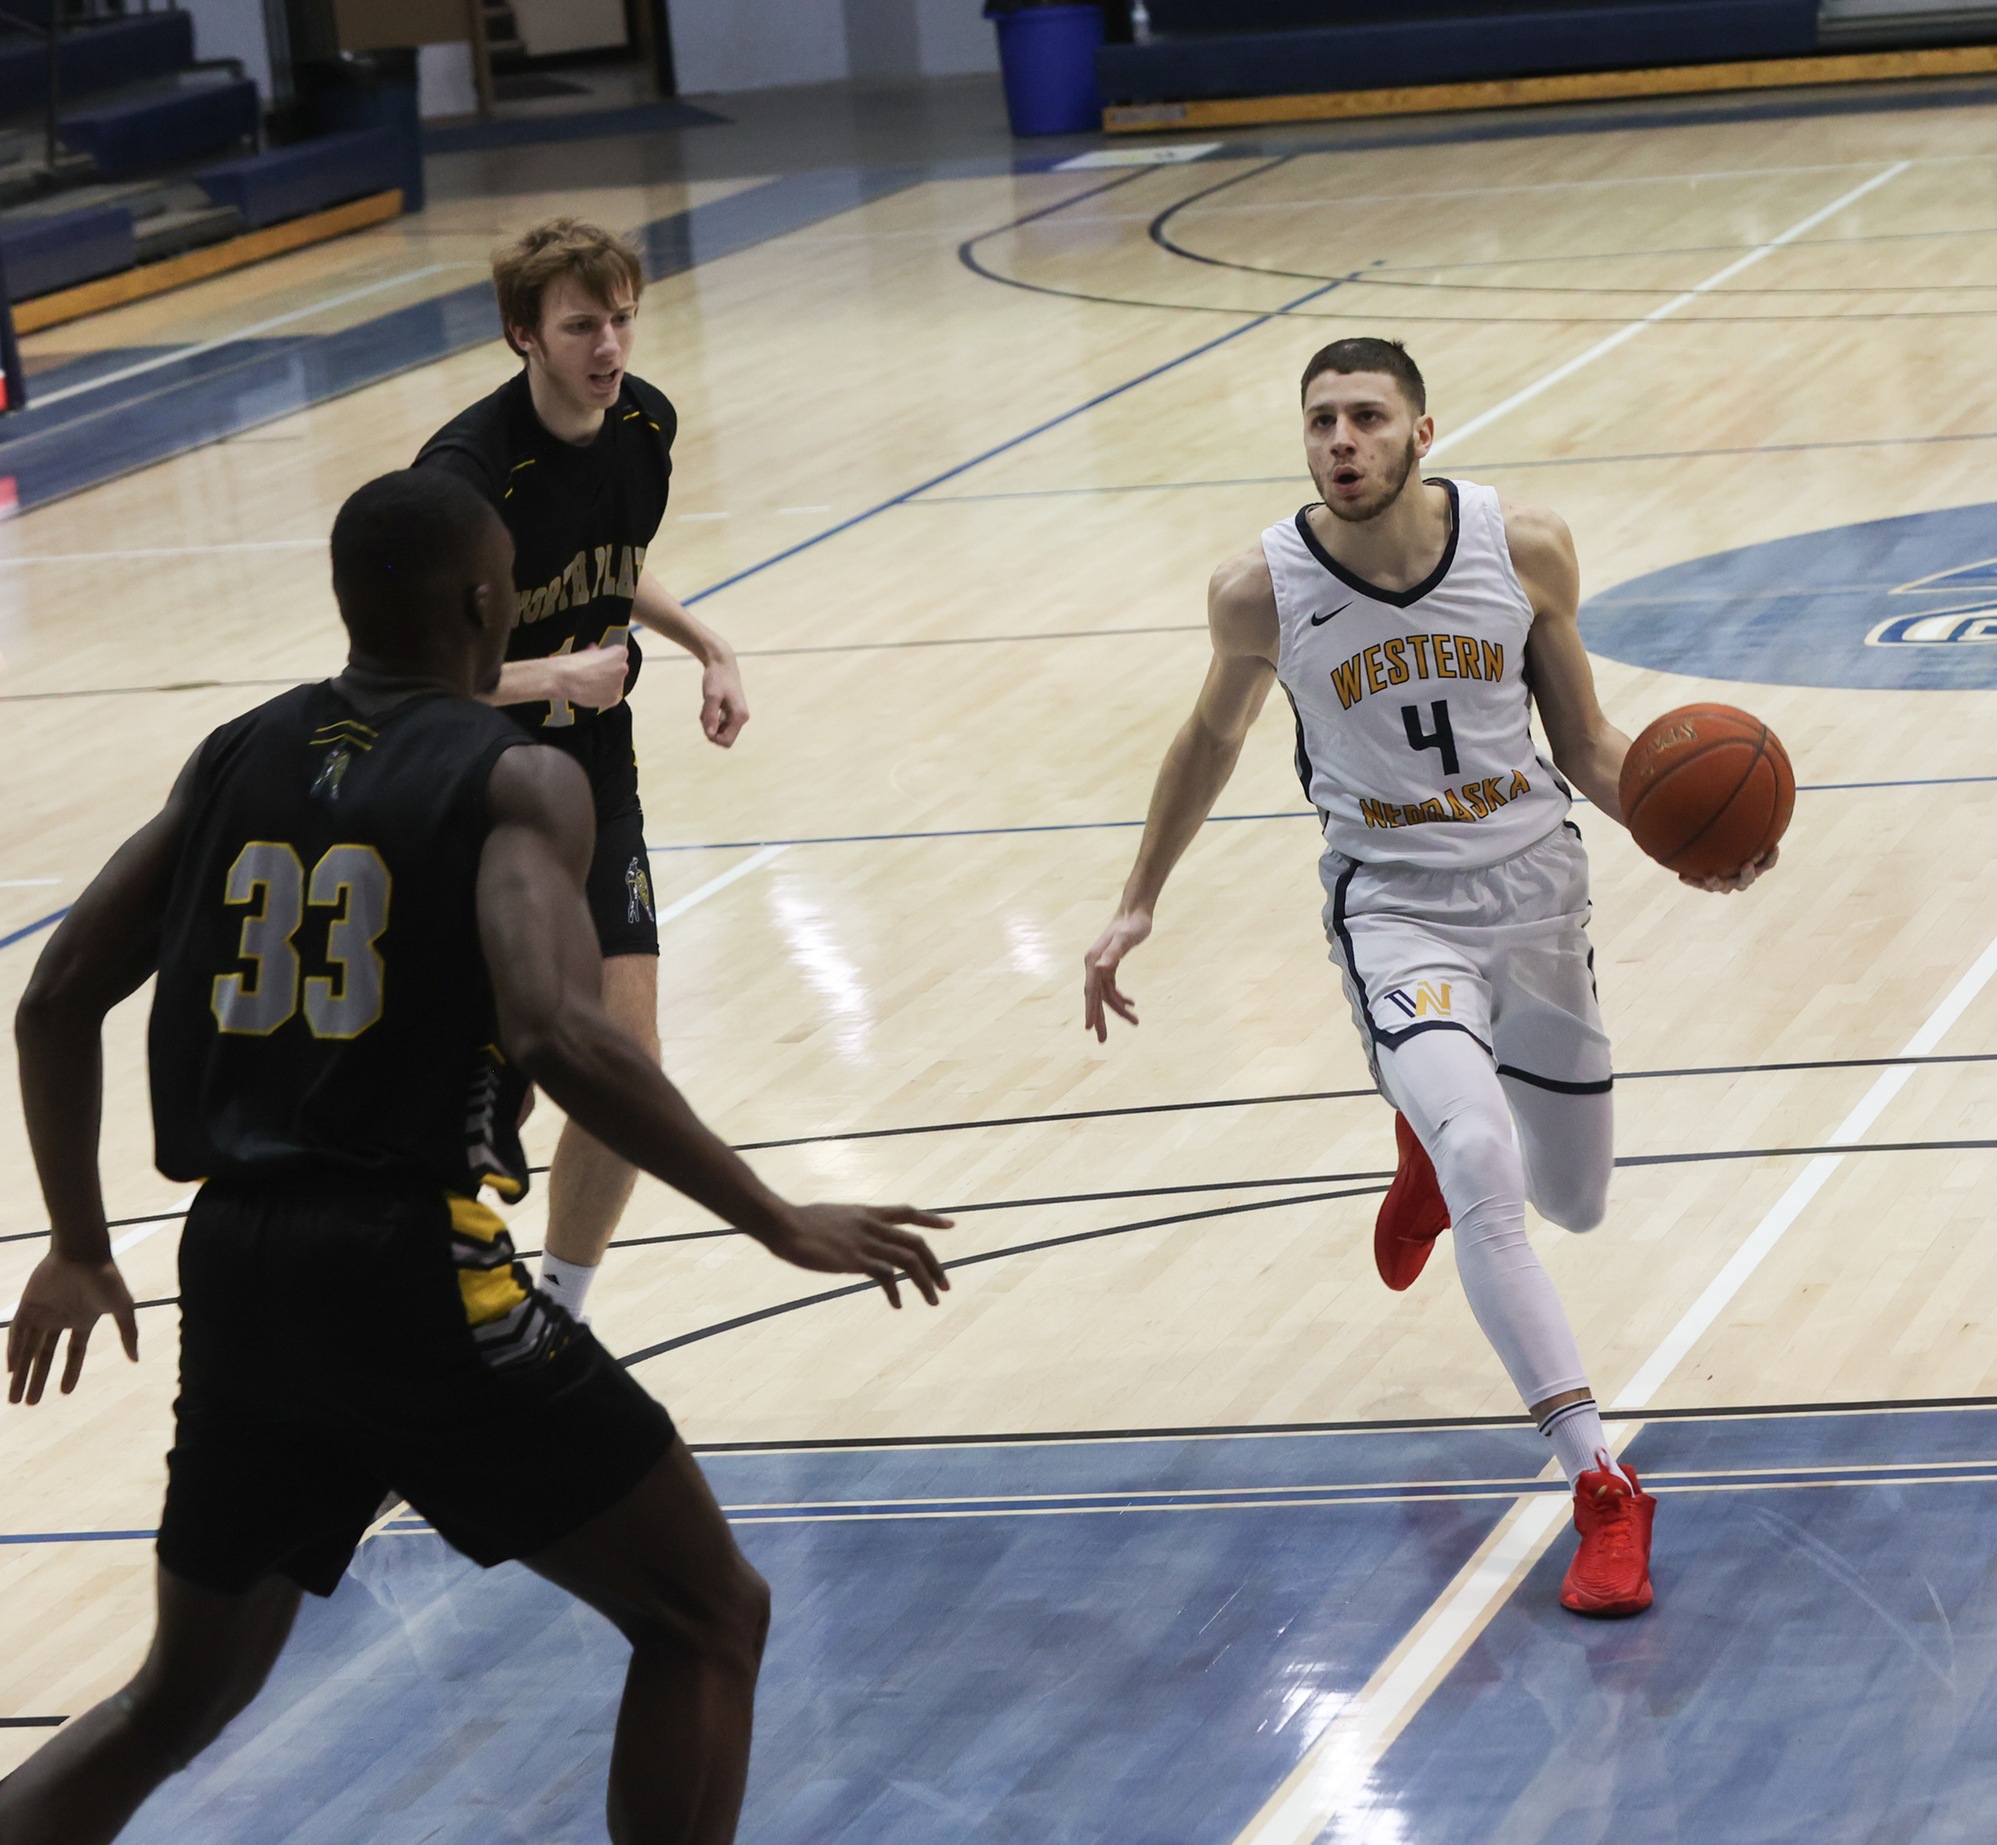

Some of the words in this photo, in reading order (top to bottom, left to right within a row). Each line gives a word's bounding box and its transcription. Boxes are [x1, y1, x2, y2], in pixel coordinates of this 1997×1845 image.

[1330, 633, 1504, 711] WESTERN
[1401, 699, 1460, 776] 4
[210, 840, 393, 1040] 33
